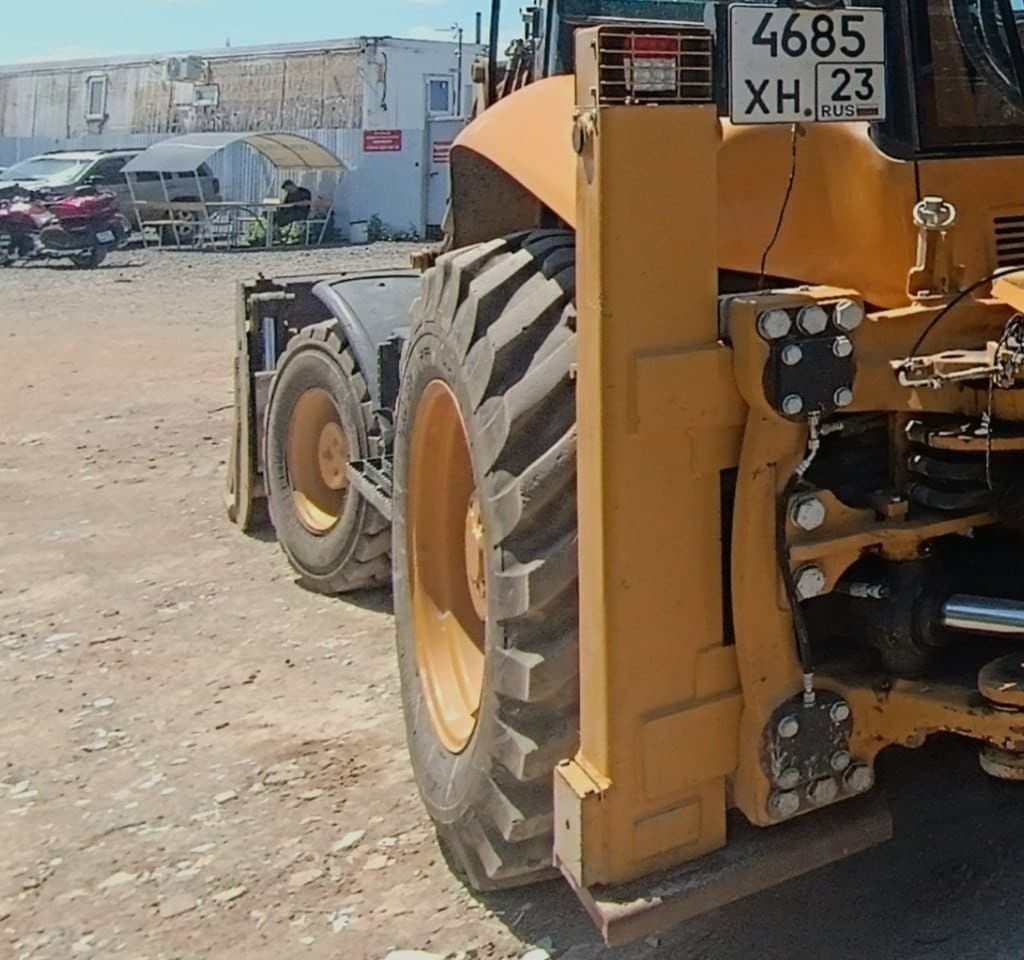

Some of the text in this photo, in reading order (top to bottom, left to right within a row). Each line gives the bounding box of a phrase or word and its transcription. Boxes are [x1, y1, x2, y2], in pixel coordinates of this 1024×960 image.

[752, 12, 866, 58] 4685
[831, 68, 874, 101] 23
[821, 105, 855, 117] RUS
